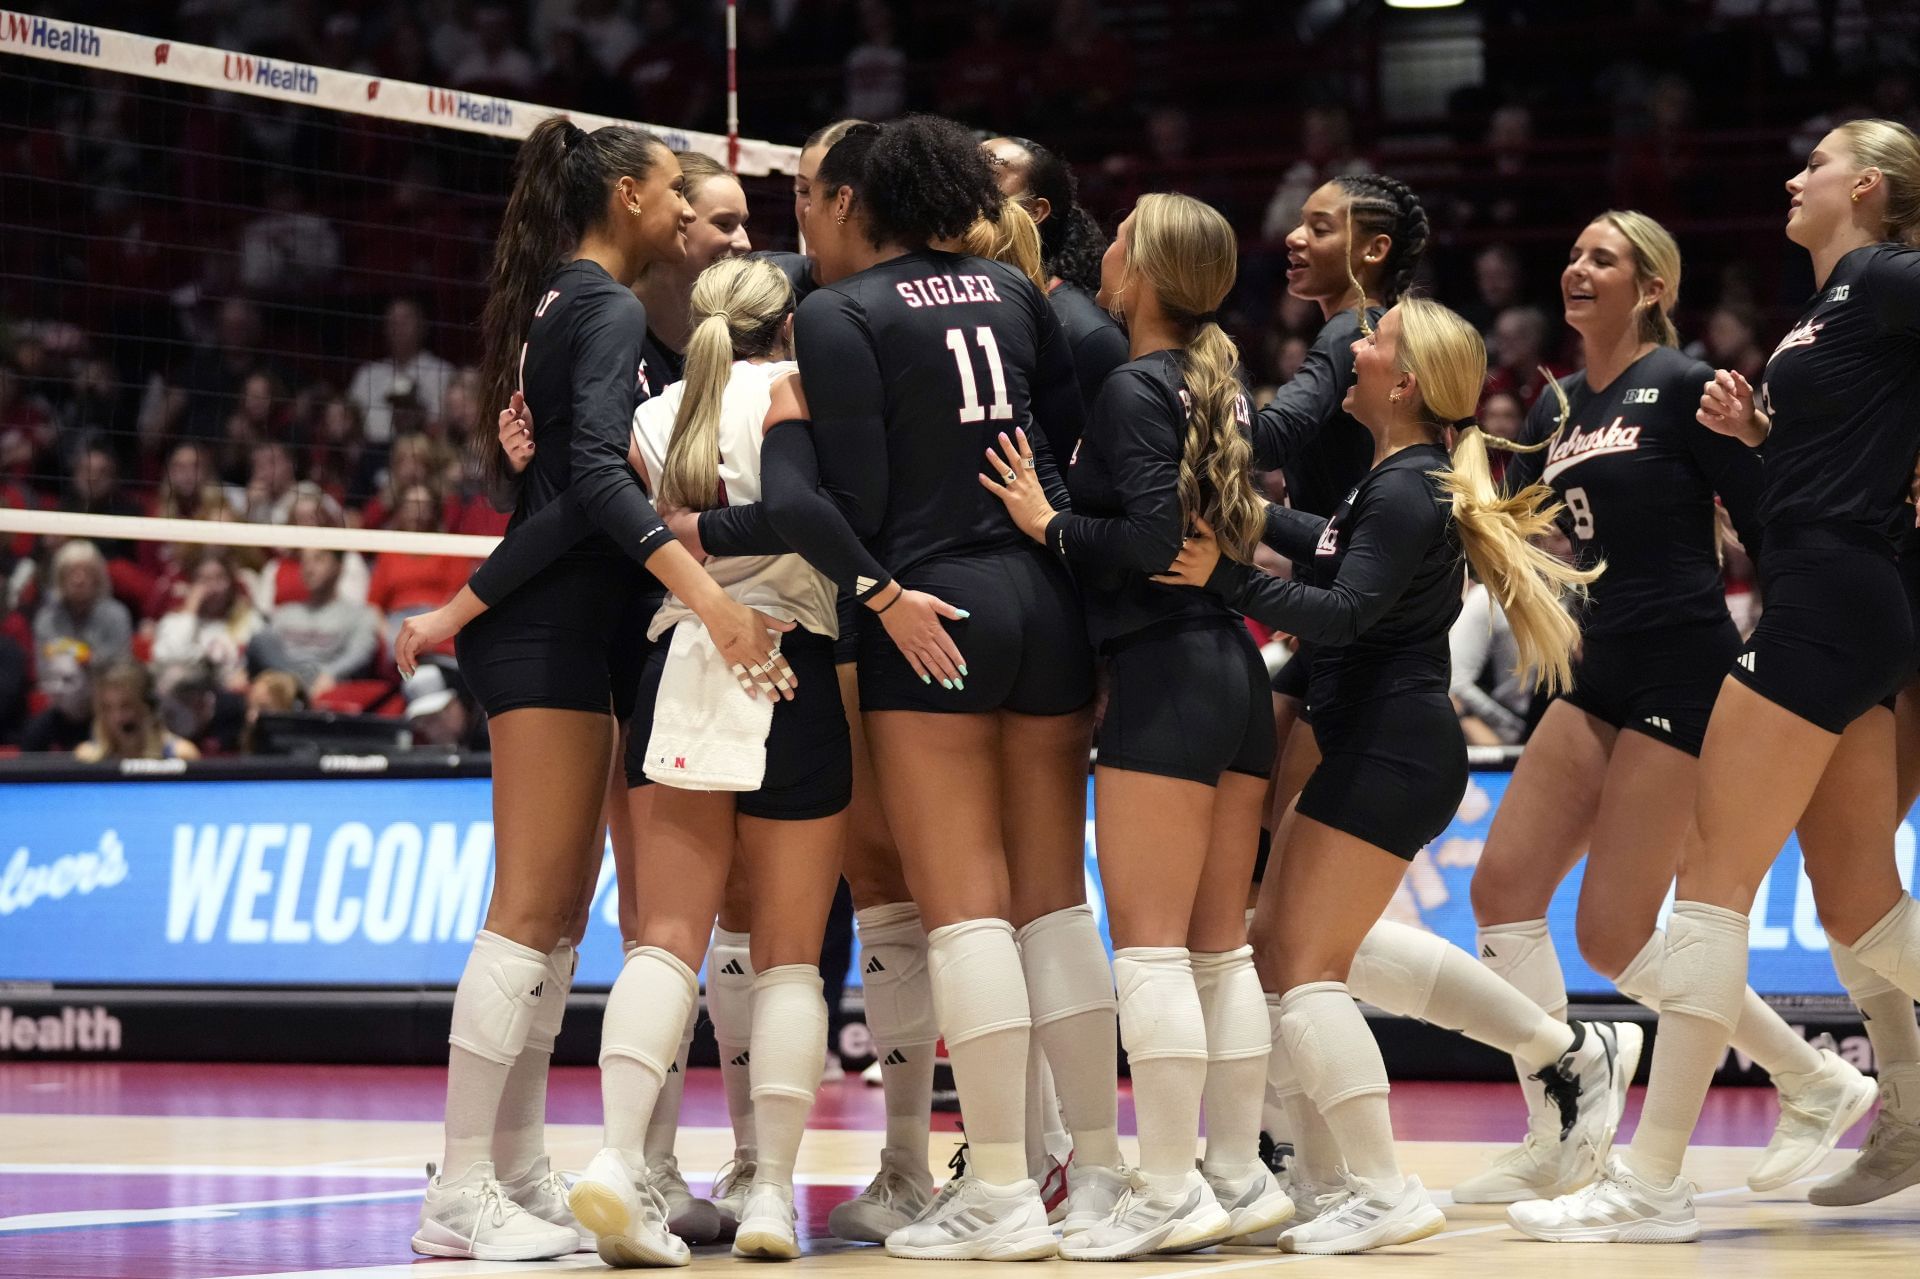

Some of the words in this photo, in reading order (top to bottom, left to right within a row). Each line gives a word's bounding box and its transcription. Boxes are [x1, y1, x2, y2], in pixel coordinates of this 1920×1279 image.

[896, 274, 1002, 308] SIGLER
[945, 326, 1014, 424] 11
[1565, 487, 1594, 540] 8
[0, 829, 128, 915] lver's
[165, 821, 496, 944] WELCOM
